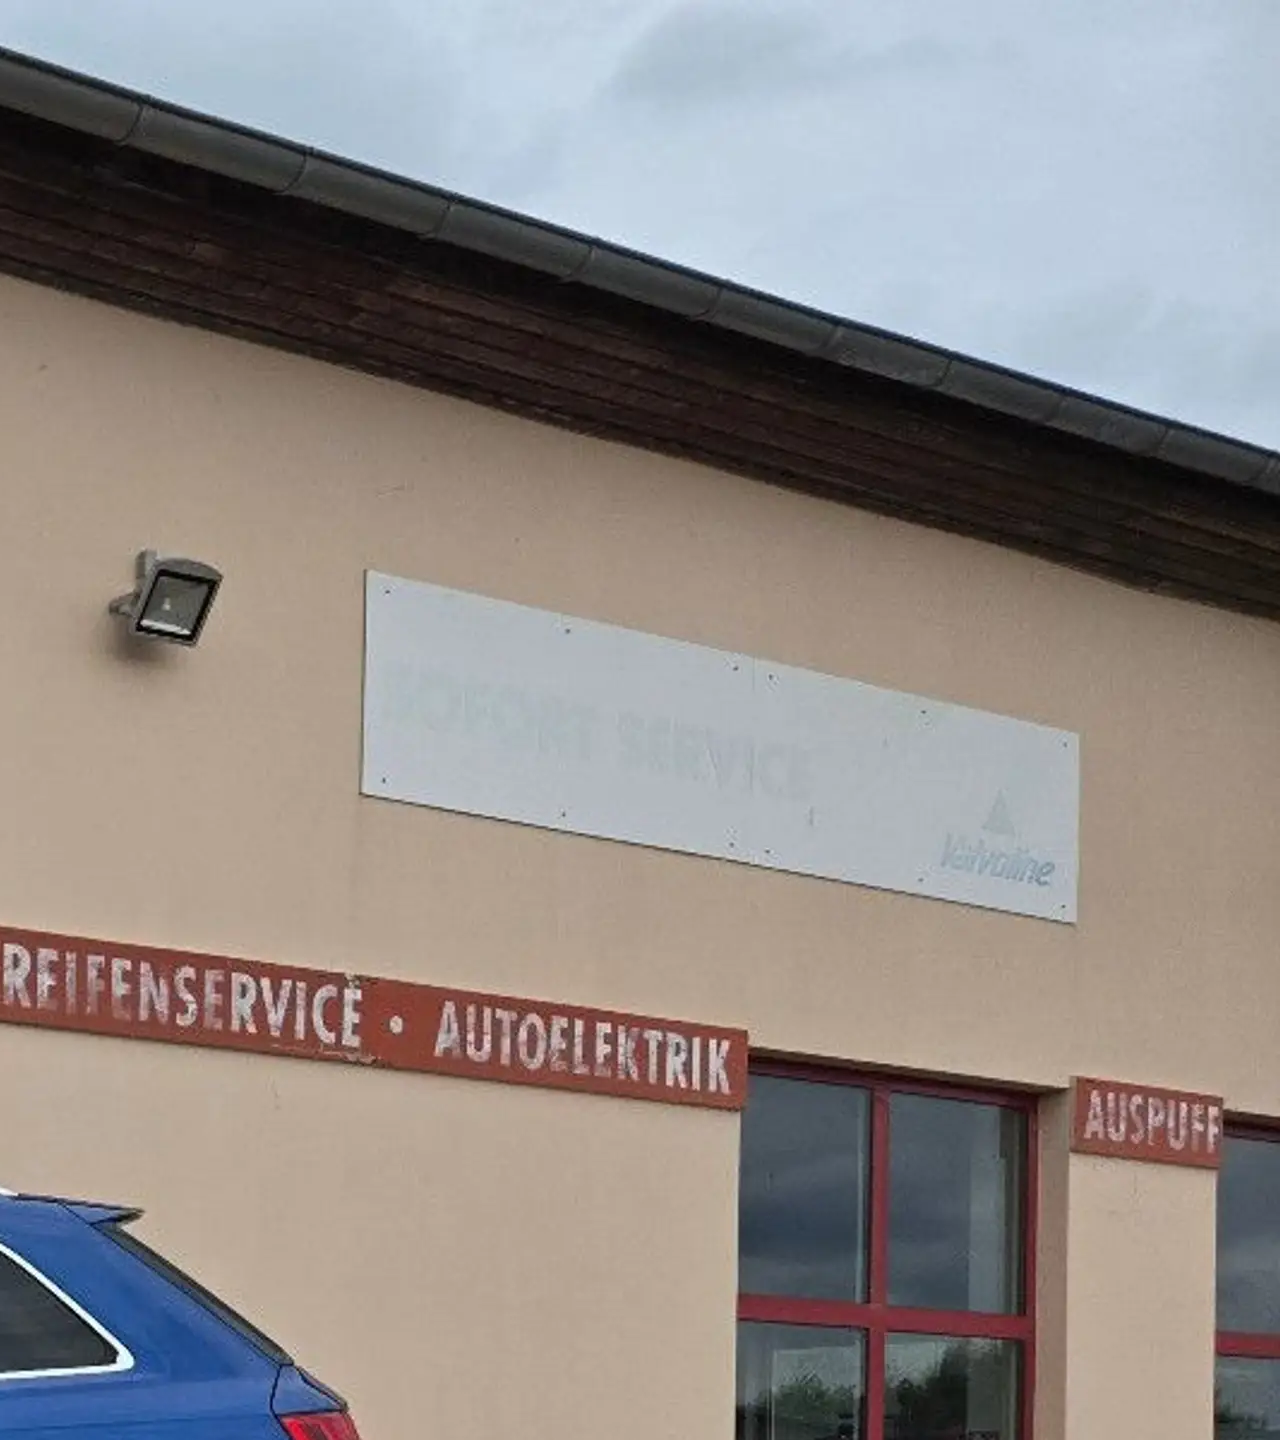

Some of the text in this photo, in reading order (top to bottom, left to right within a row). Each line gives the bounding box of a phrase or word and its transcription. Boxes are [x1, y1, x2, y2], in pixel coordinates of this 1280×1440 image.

[3, 942, 363, 1049] REIFENSERVICE
[434, 999, 731, 1095] AUTOELEKTRIK
[1083, 1089, 1219, 1154] AUSPUFF
